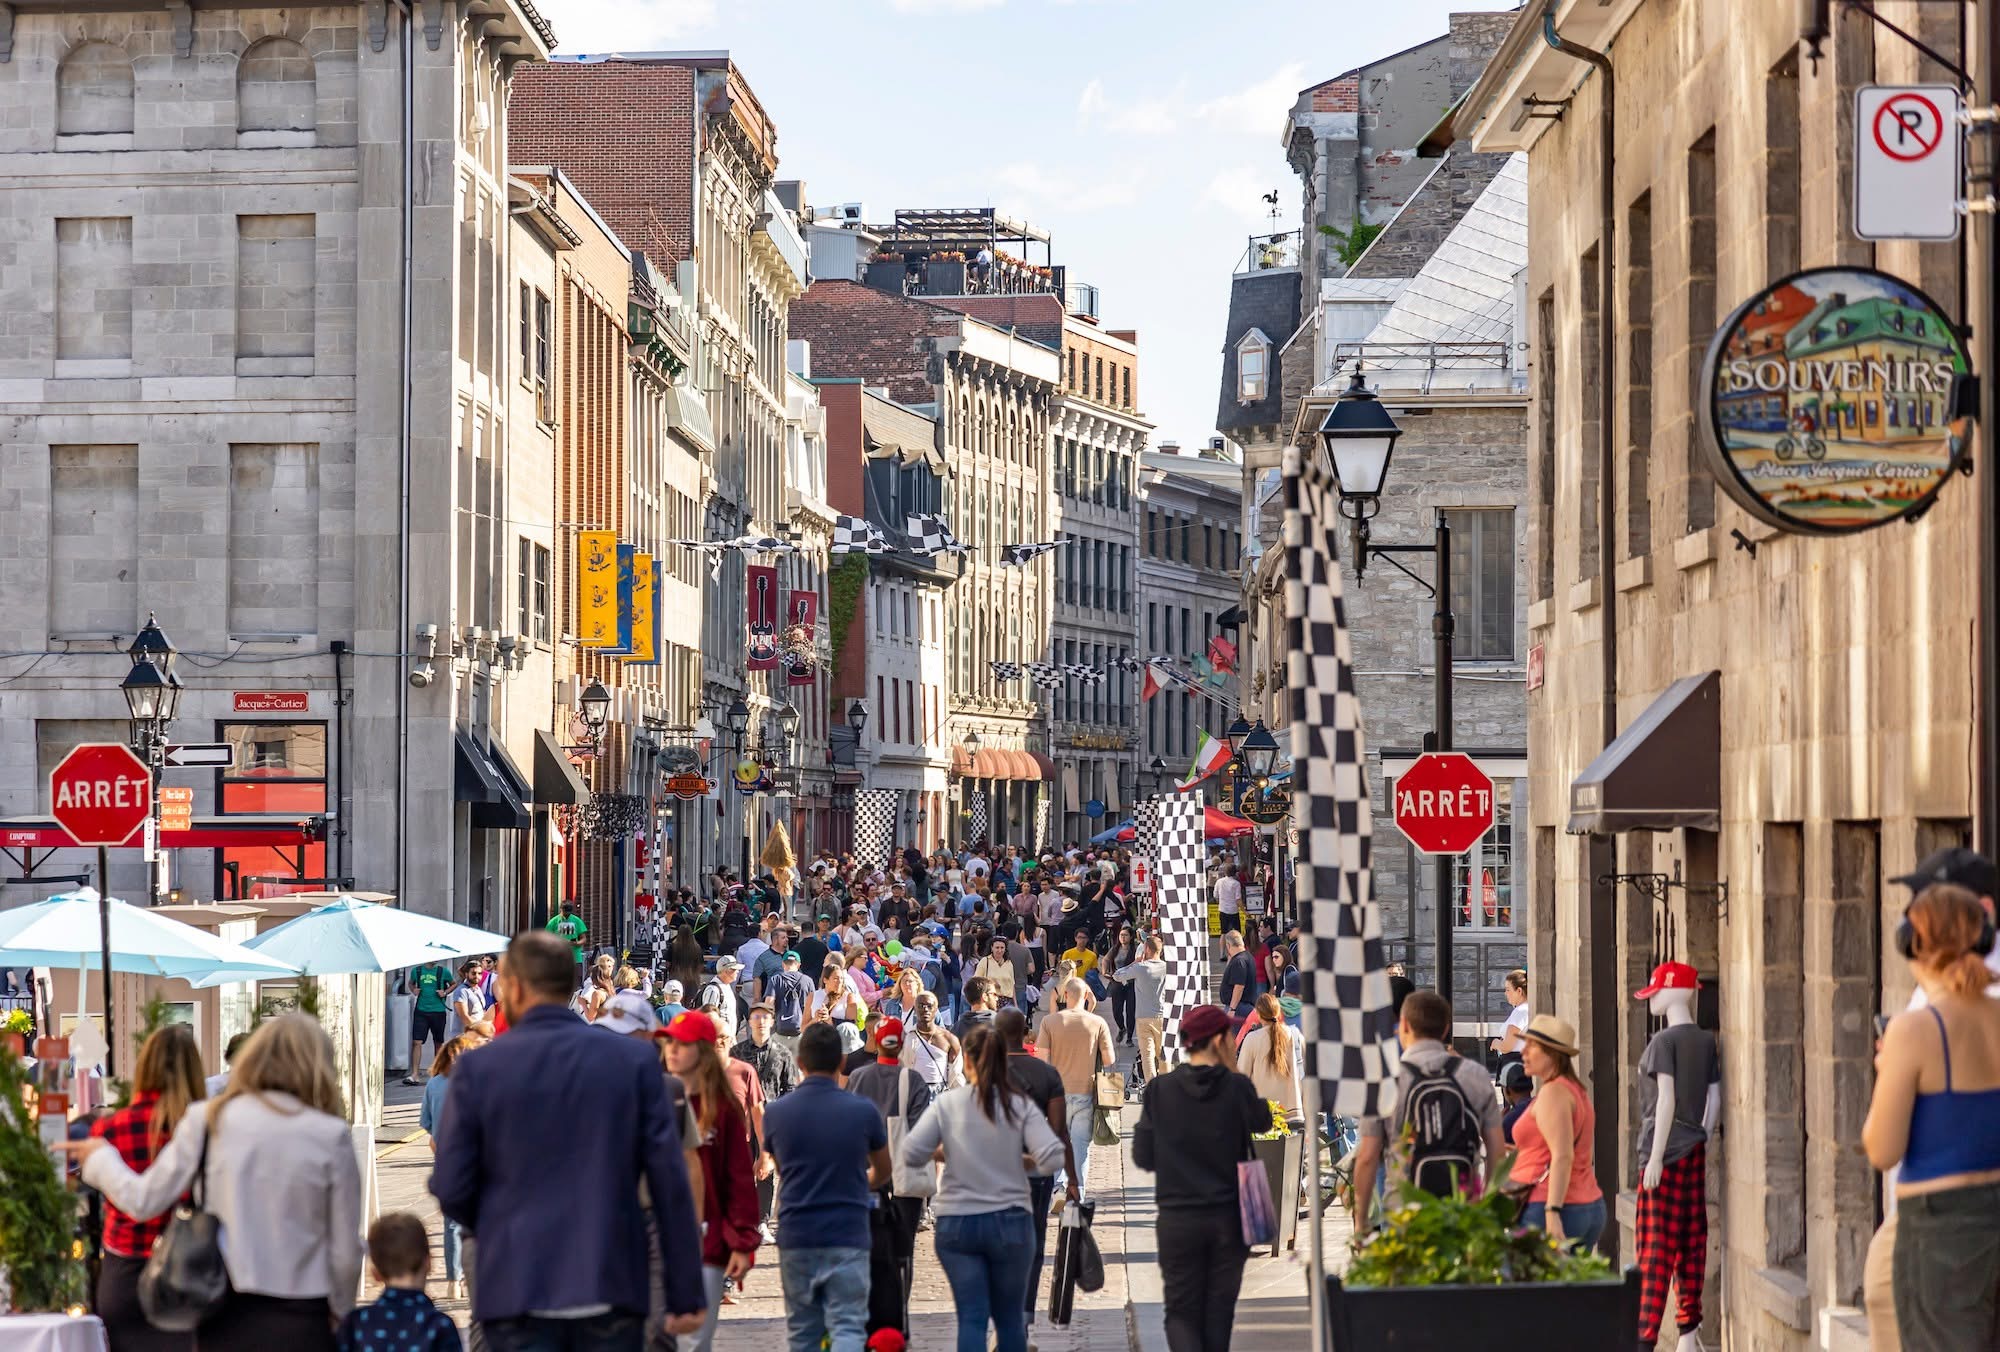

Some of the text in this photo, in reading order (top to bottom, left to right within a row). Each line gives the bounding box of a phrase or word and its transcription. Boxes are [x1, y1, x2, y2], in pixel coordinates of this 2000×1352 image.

[1729, 360, 1954, 393] SOUVENIRS
[1753, 460, 1931, 480] Place Jacques Cartier
[237, 699, 305, 711] Jacques-Cartier
[56, 774, 147, 809] ARRÊT
[676, 780, 699, 789] KEBAB
[1399, 784, 1490, 818] ARRÊT
